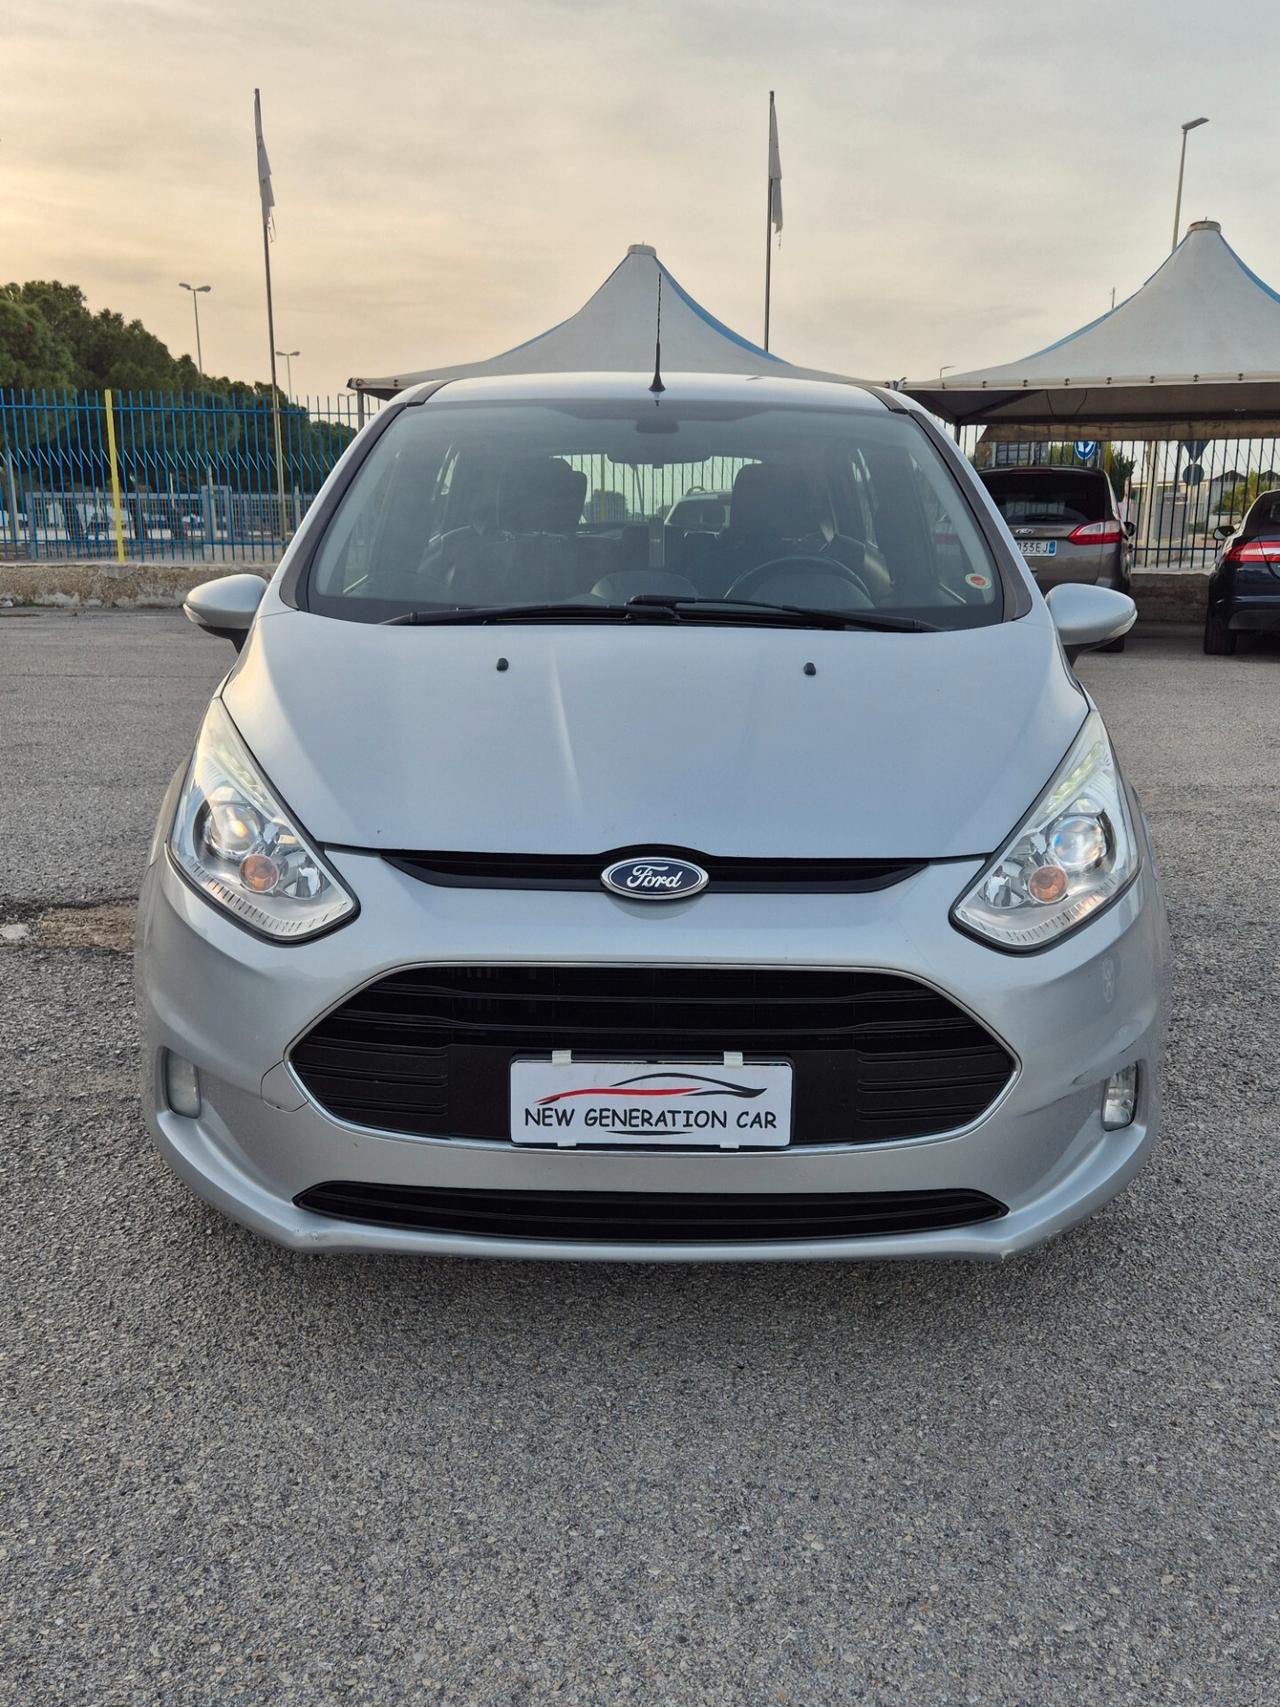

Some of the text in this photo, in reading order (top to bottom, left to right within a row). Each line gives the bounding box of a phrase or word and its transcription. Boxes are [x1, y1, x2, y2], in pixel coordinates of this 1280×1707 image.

[626, 864, 683, 888] Ford
[524, 1107, 777, 1129] NEW GENERATION CAR
